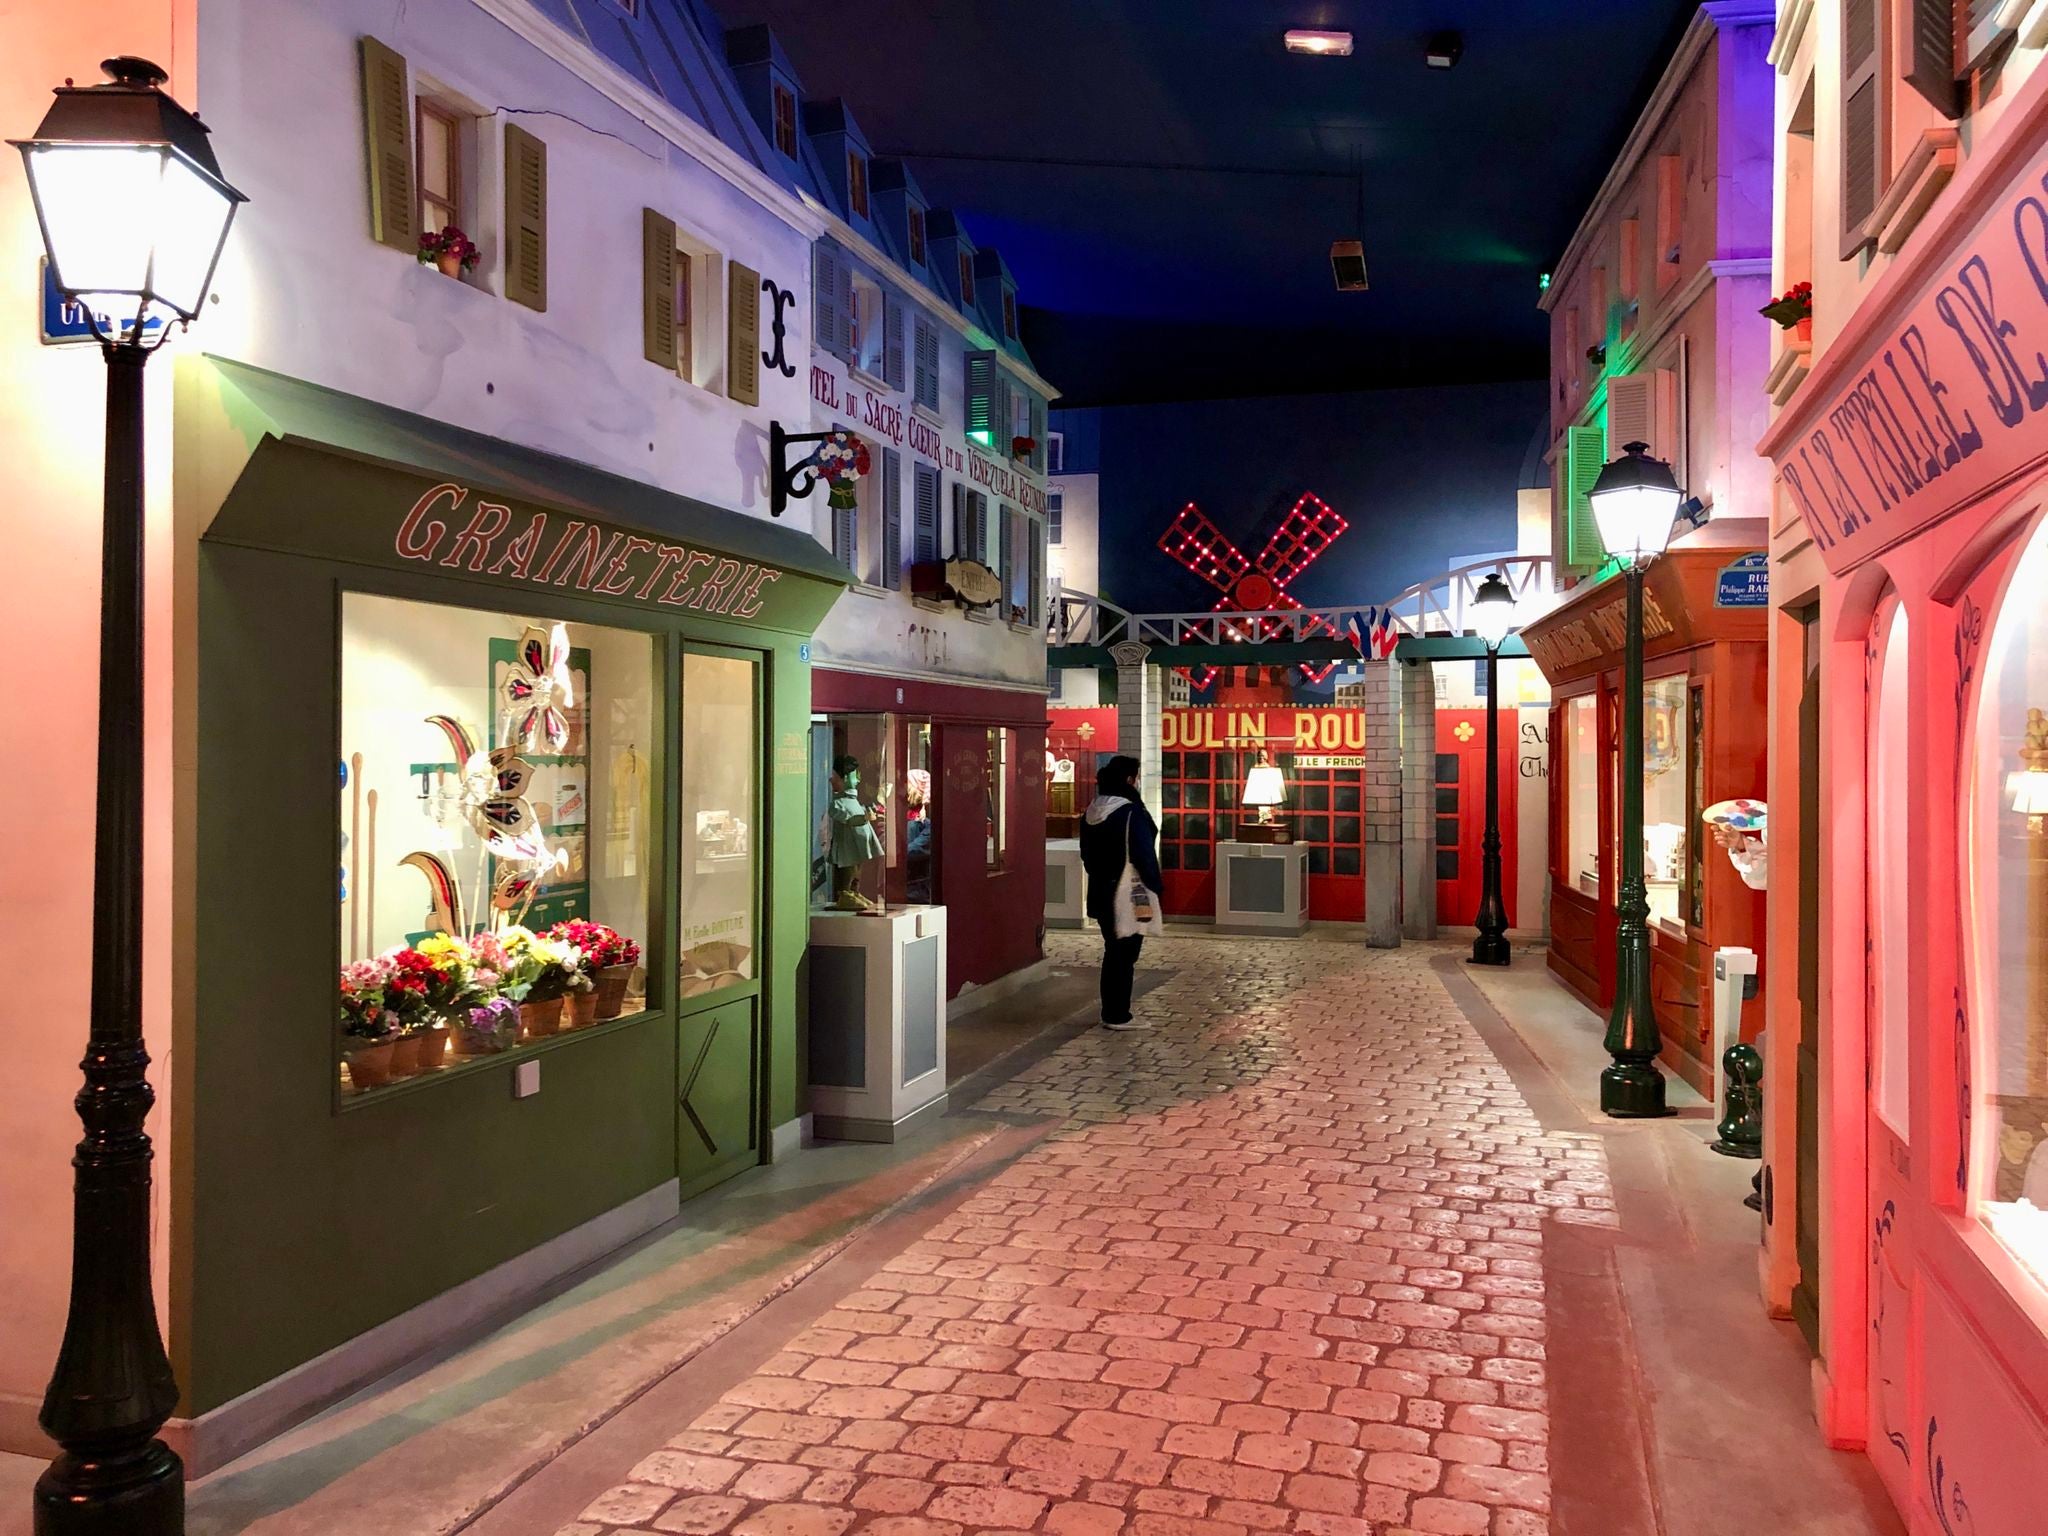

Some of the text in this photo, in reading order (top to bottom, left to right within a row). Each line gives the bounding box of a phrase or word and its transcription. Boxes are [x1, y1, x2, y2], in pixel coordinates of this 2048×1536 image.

[809, 365, 840, 410] TEL
[846, 392, 858, 418] DU
[865, 391, 903, 447] SACRÉ
[908, 417, 944, 470] CŒUR
[945, 446, 954, 469] ET
[967, 448, 1017, 500] VENEZUELA
[1800, 429, 1872, 538] LA
[1936, 253, 2048, 429] DE
[395, 483, 782, 618] GRAINETERIE
[1296, 713, 1366, 749] ROU
[1520, 756, 1549, 779] Th
